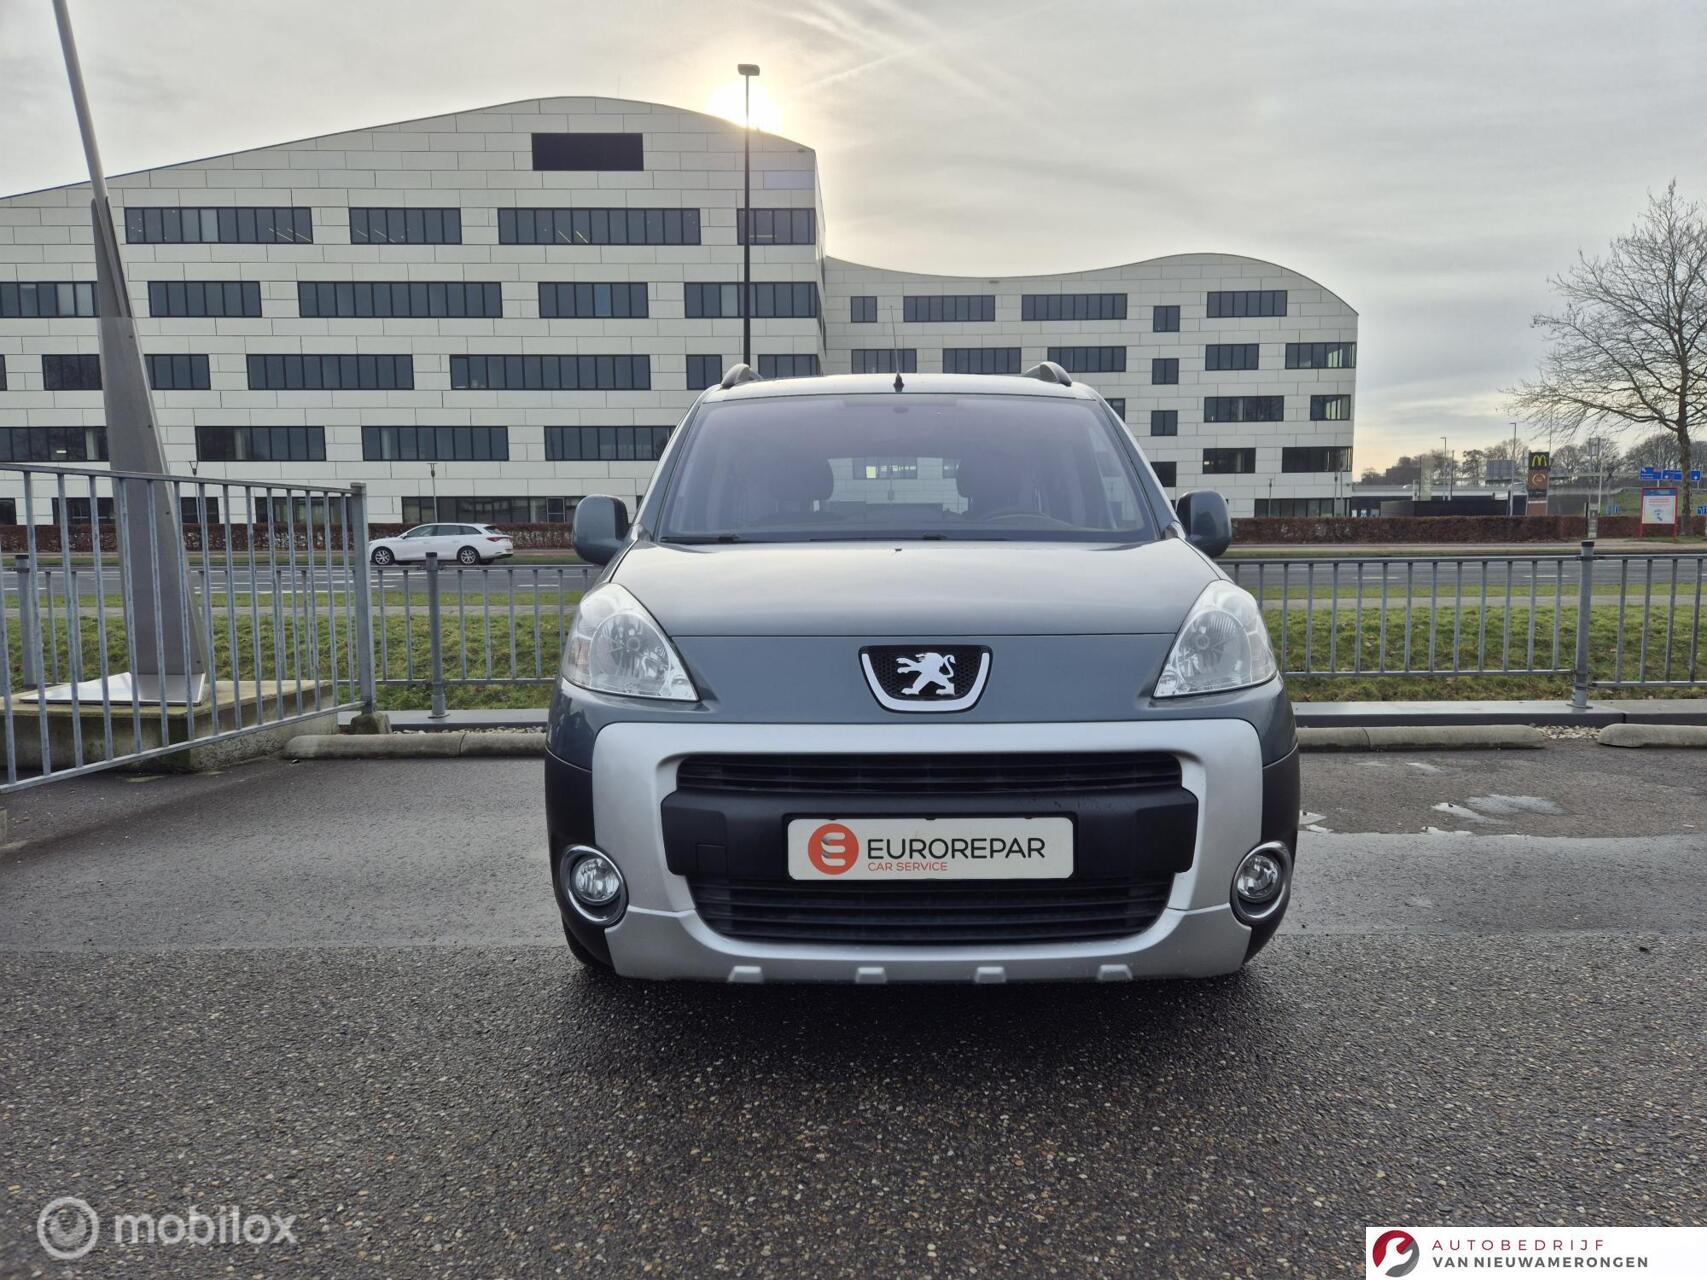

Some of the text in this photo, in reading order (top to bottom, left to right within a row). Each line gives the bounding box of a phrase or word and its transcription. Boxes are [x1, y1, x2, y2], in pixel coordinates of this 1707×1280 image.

[867, 837, 1046, 859] EUROREPAR
[867, 862, 948, 872] CAR SERVICE
